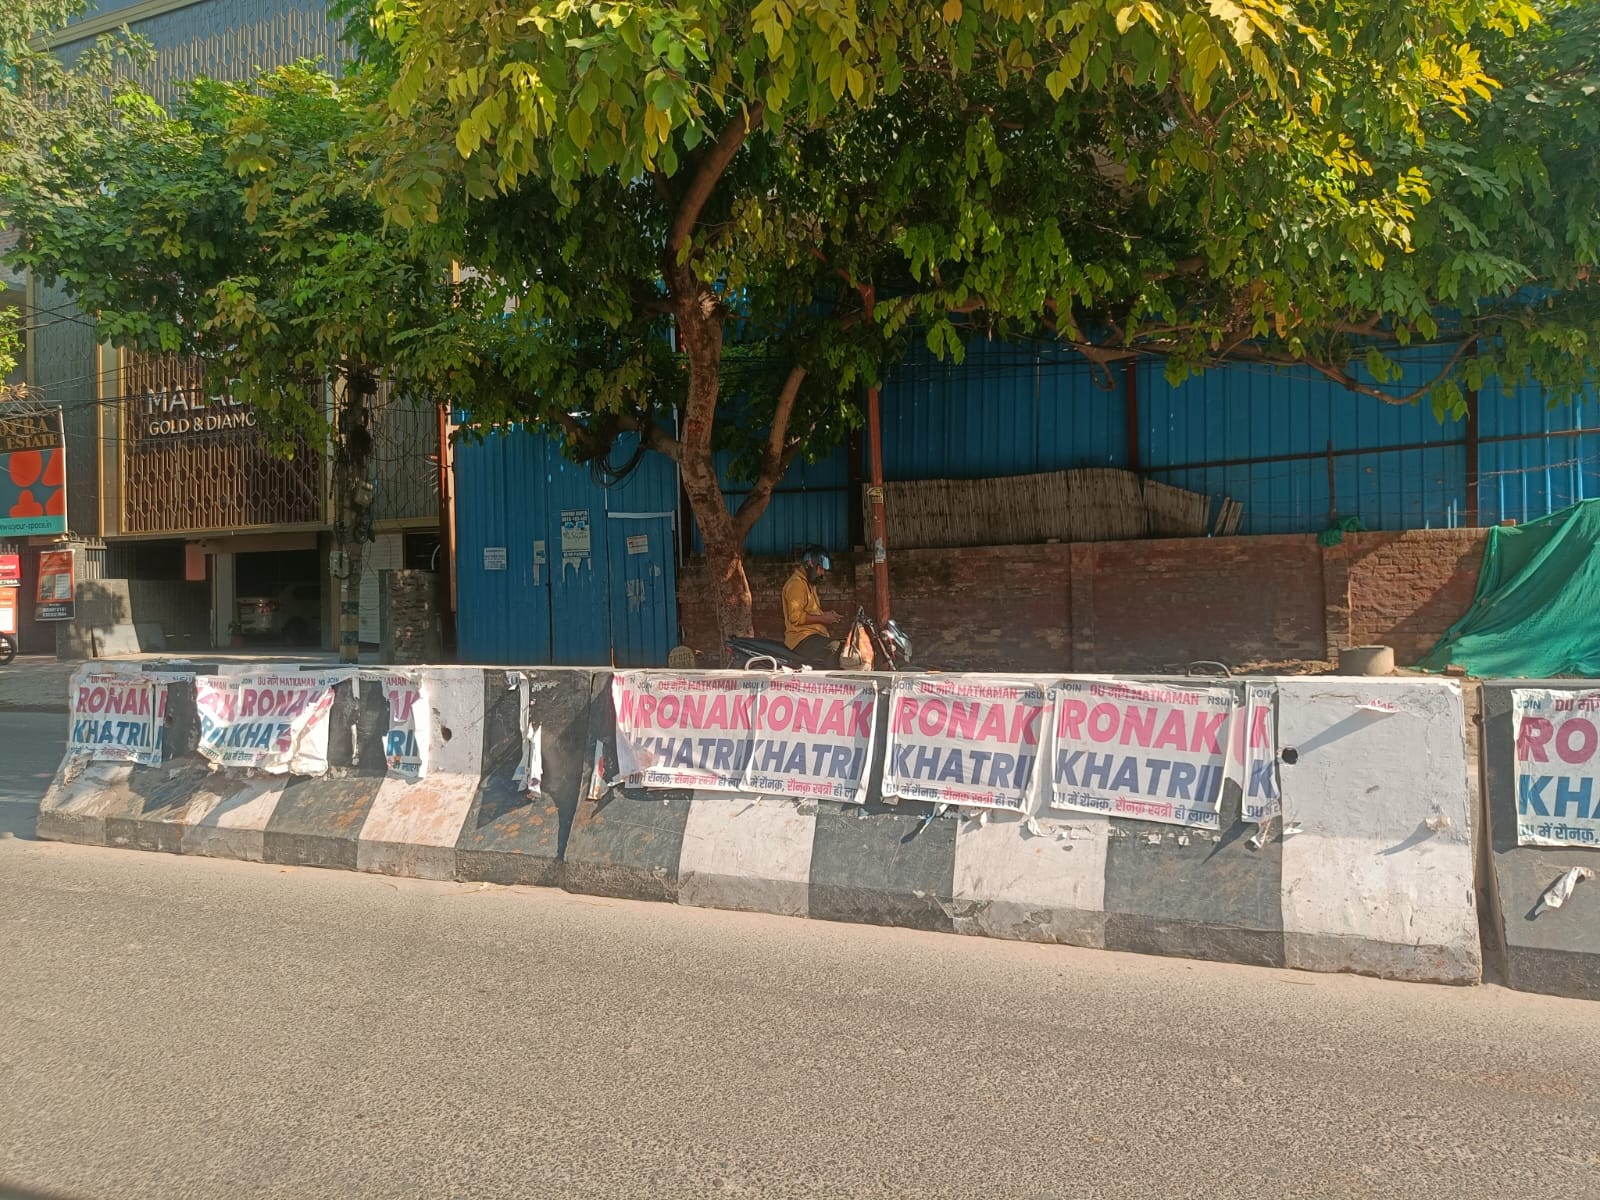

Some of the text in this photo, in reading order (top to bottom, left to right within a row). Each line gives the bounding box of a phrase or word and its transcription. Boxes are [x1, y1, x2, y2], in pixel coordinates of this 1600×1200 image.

[149, 419, 190, 435] GOLD
[193, 416, 204, 432] &
[920, 681, 934, 694] DU
[957, 683, 1018, 699] MATKAMAN
[1061, 682, 1082, 692] JOIN
[1130, 688, 1200, 706] MATKAMAN
[1555, 699, 1574, 712] DU
[634, 694, 756, 730] RONAK
[891, 696, 1042, 745] RONAK
[1056, 698, 1229, 755] RONAK
[888, 744, 1027, 789] KHATRI
[1519, 774, 1600, 819] KH
